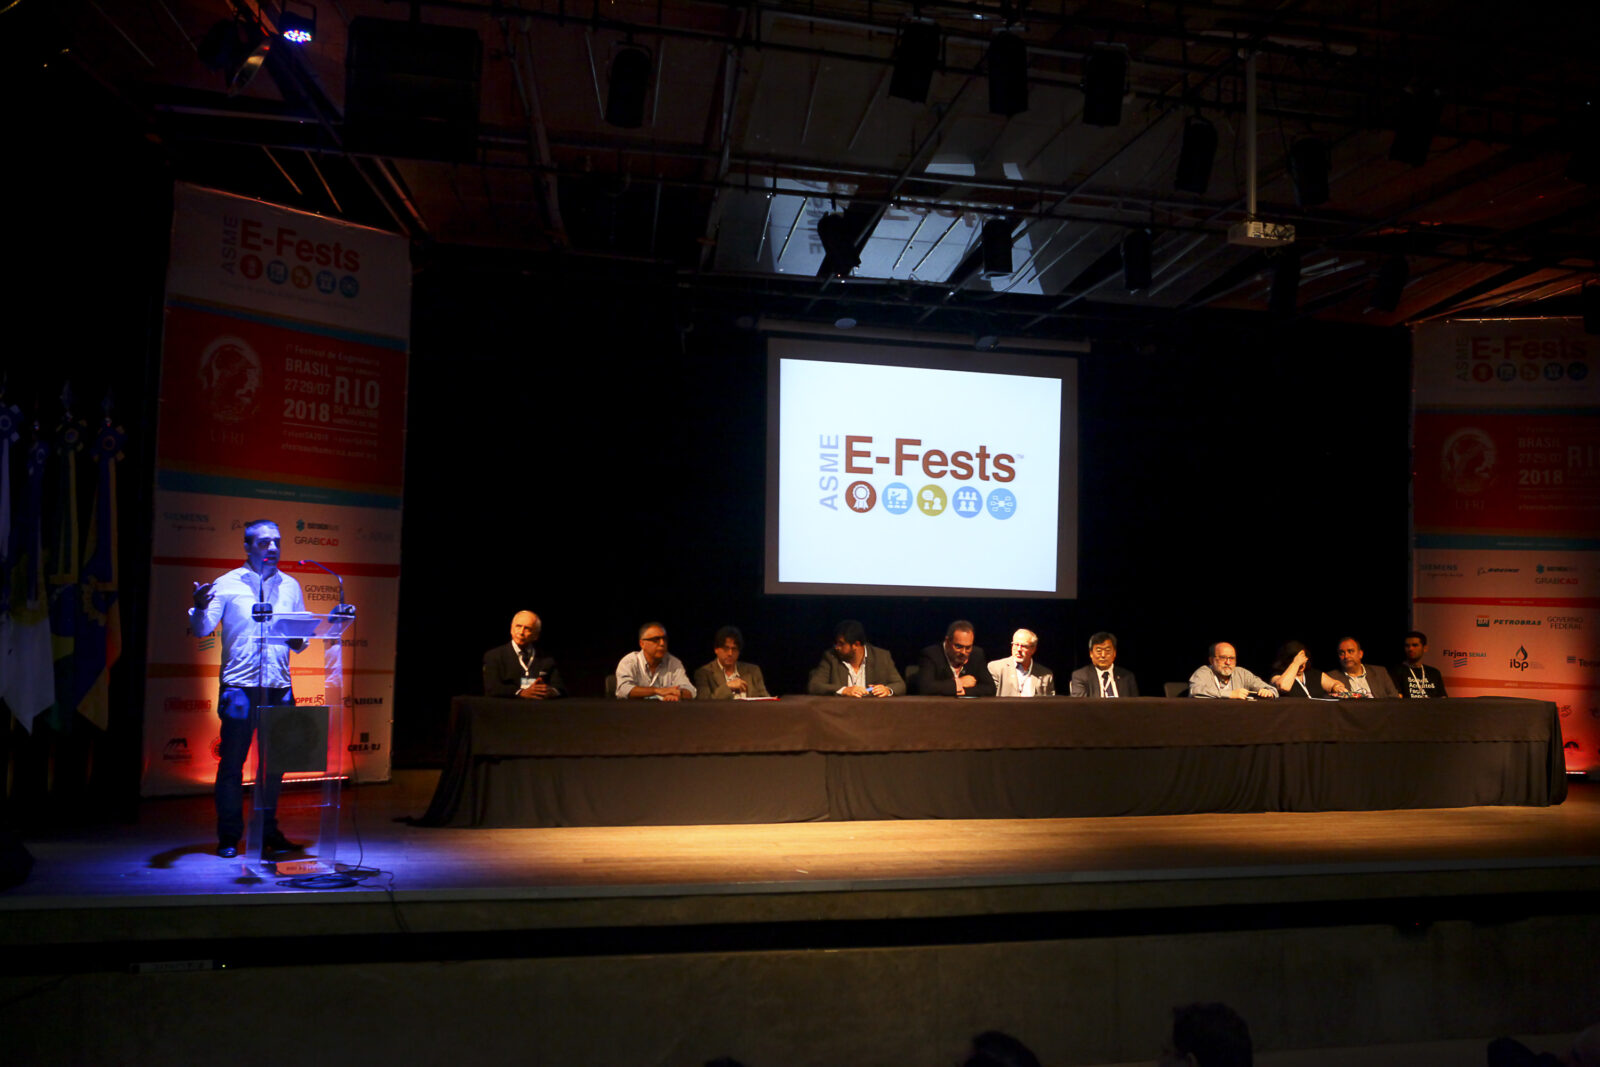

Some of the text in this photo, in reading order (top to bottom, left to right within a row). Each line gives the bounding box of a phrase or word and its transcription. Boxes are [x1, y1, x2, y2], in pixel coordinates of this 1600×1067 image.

[221, 215, 237, 275] ASME
[240, 219, 360, 272] E-Fests
[1472, 336, 1588, 360] E-Fests
[285, 357, 332, 377] BRASIL
[334, 375, 380, 408] RIO
[282, 398, 330, 423] 2018
[845, 435, 1016, 483] E-Fests
[819, 434, 839, 511] ASME
[1519, 469, 1563, 486] 2018
[295, 536, 340, 547] GRABCAD
[304, 584, 342, 594] GOVERNO
[307, 592, 341, 602] FEDERAL
[1493, 619, 1542, 627] PETROBRAS
[1443, 649, 1468, 659] Firjan
[1510, 658, 1529, 672] ibp
